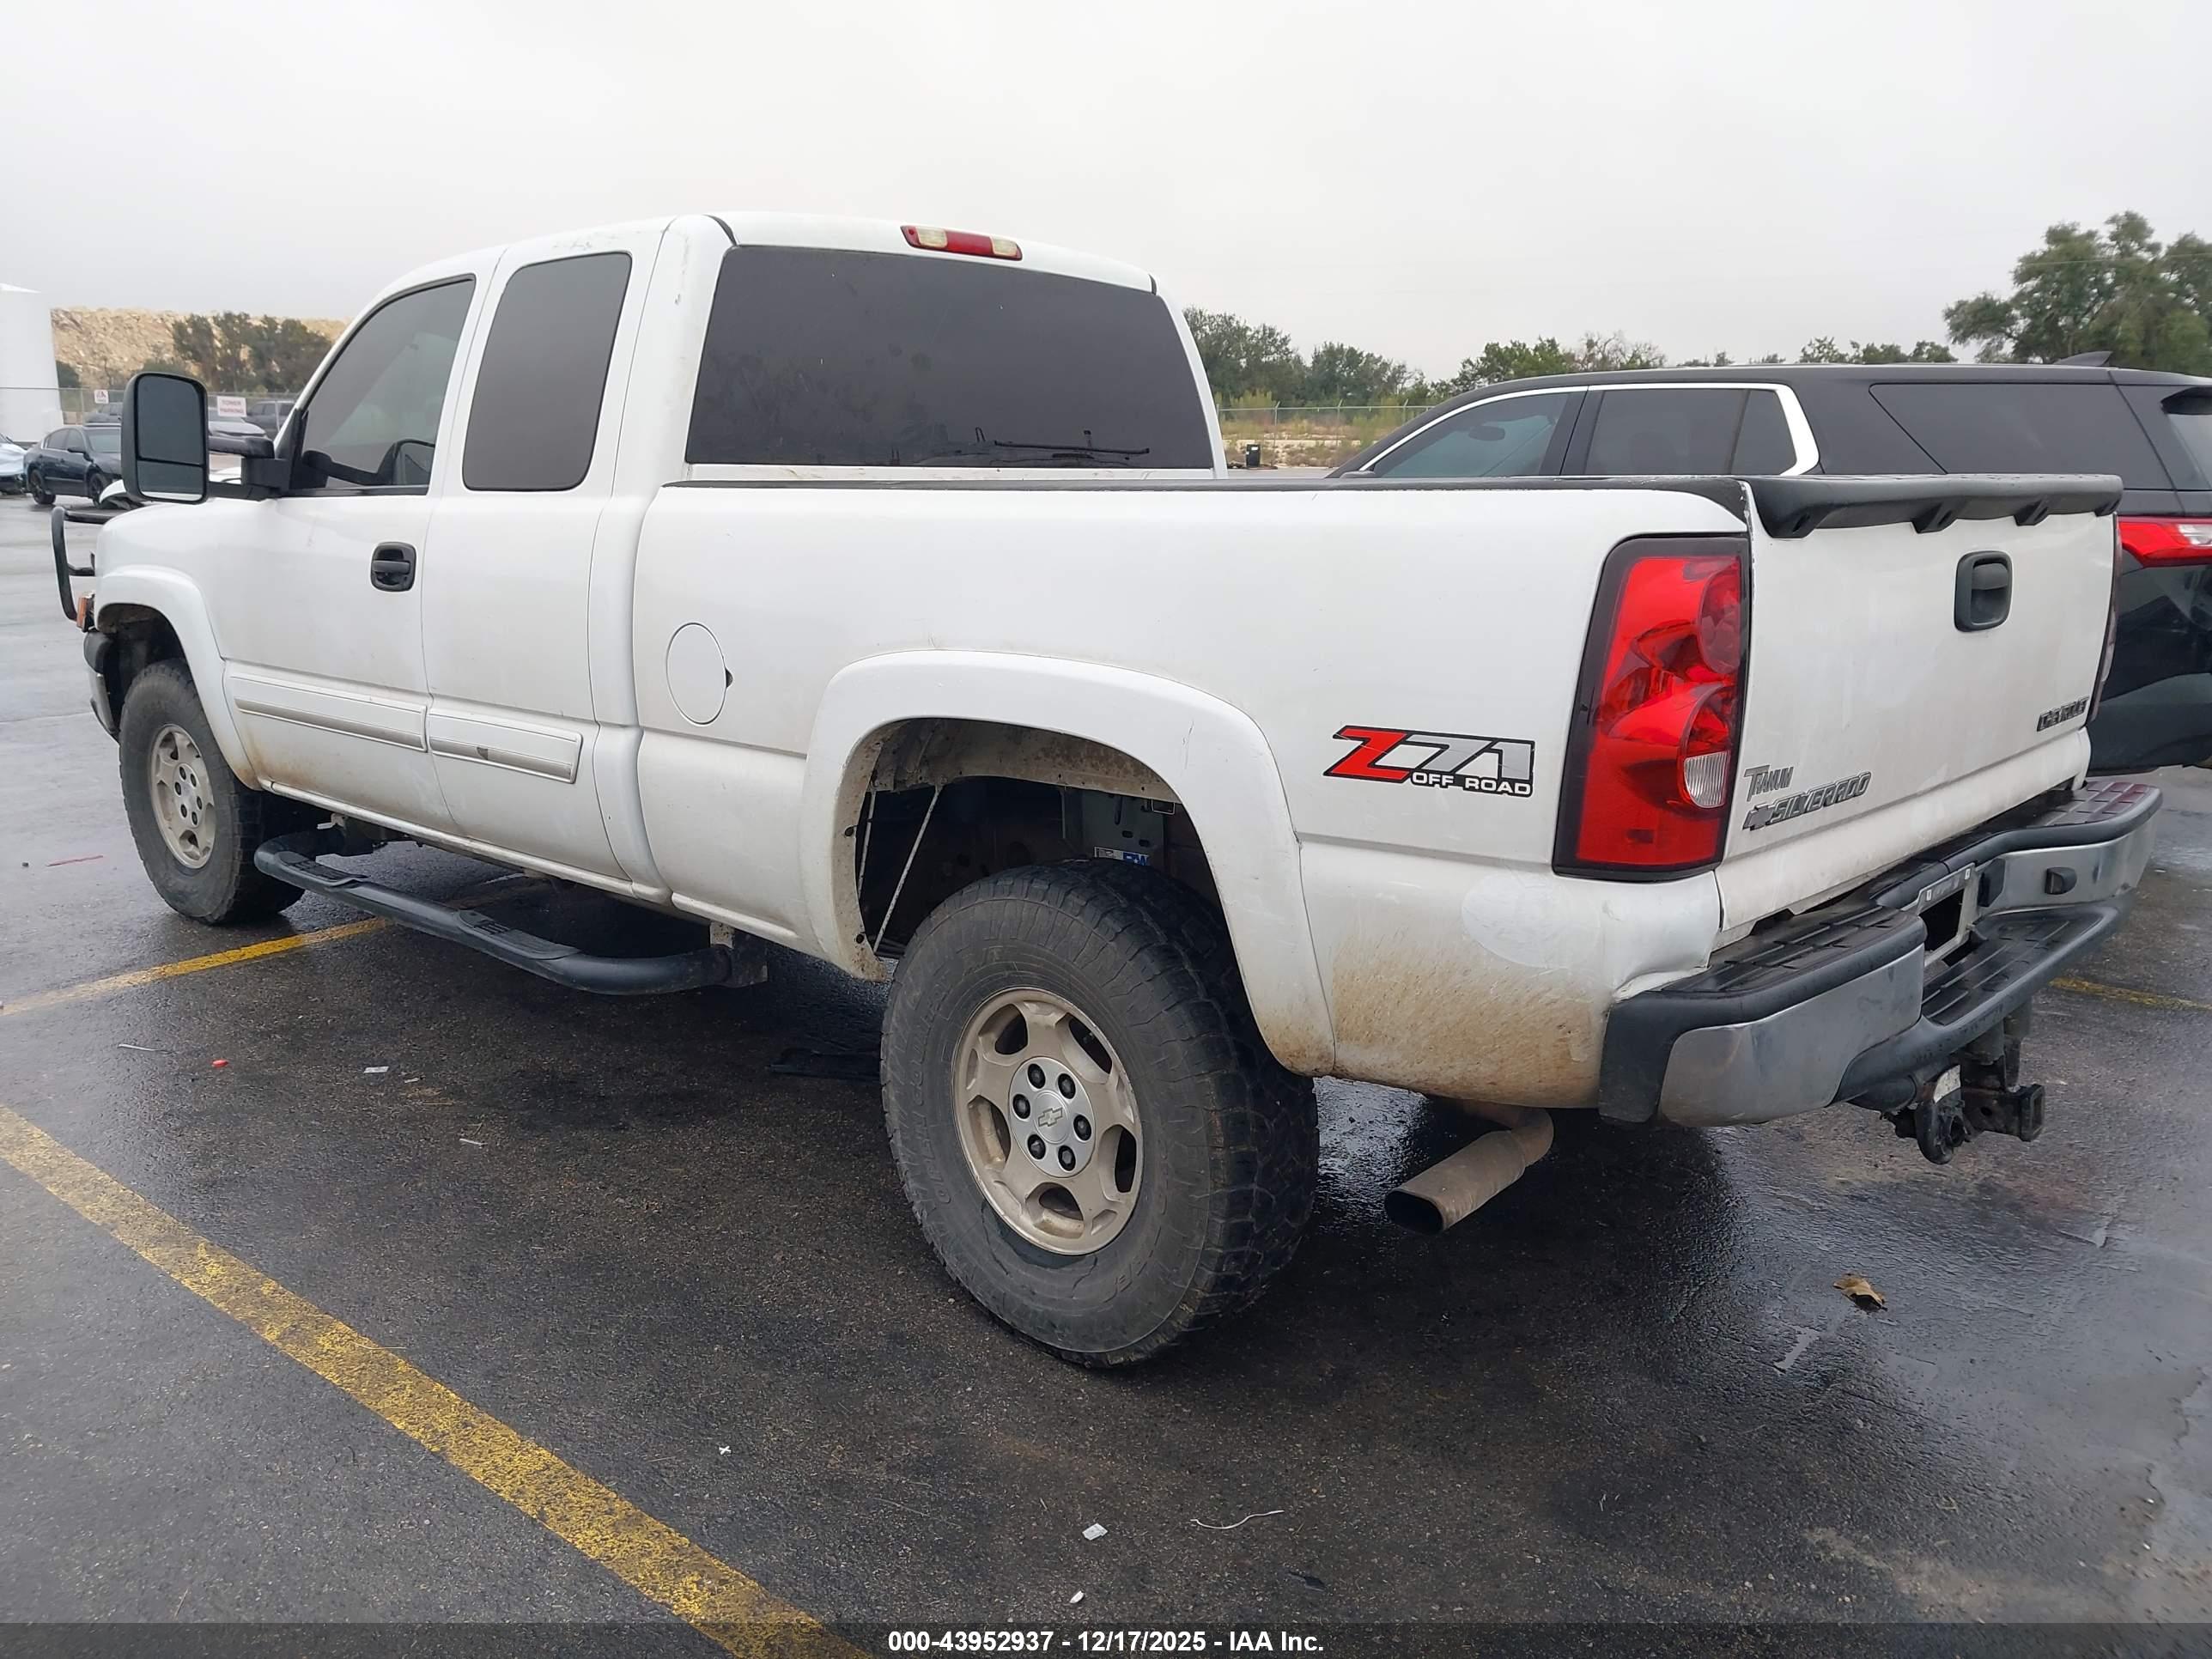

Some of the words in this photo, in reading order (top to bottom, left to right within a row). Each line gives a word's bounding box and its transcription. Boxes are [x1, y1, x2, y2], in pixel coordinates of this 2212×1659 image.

[1323, 725, 1535, 784] Z71
[1411, 771, 1455, 787] OFF
[1464, 776, 1531, 795] ROAD
[1769, 771, 1872, 825] SILVERADO
